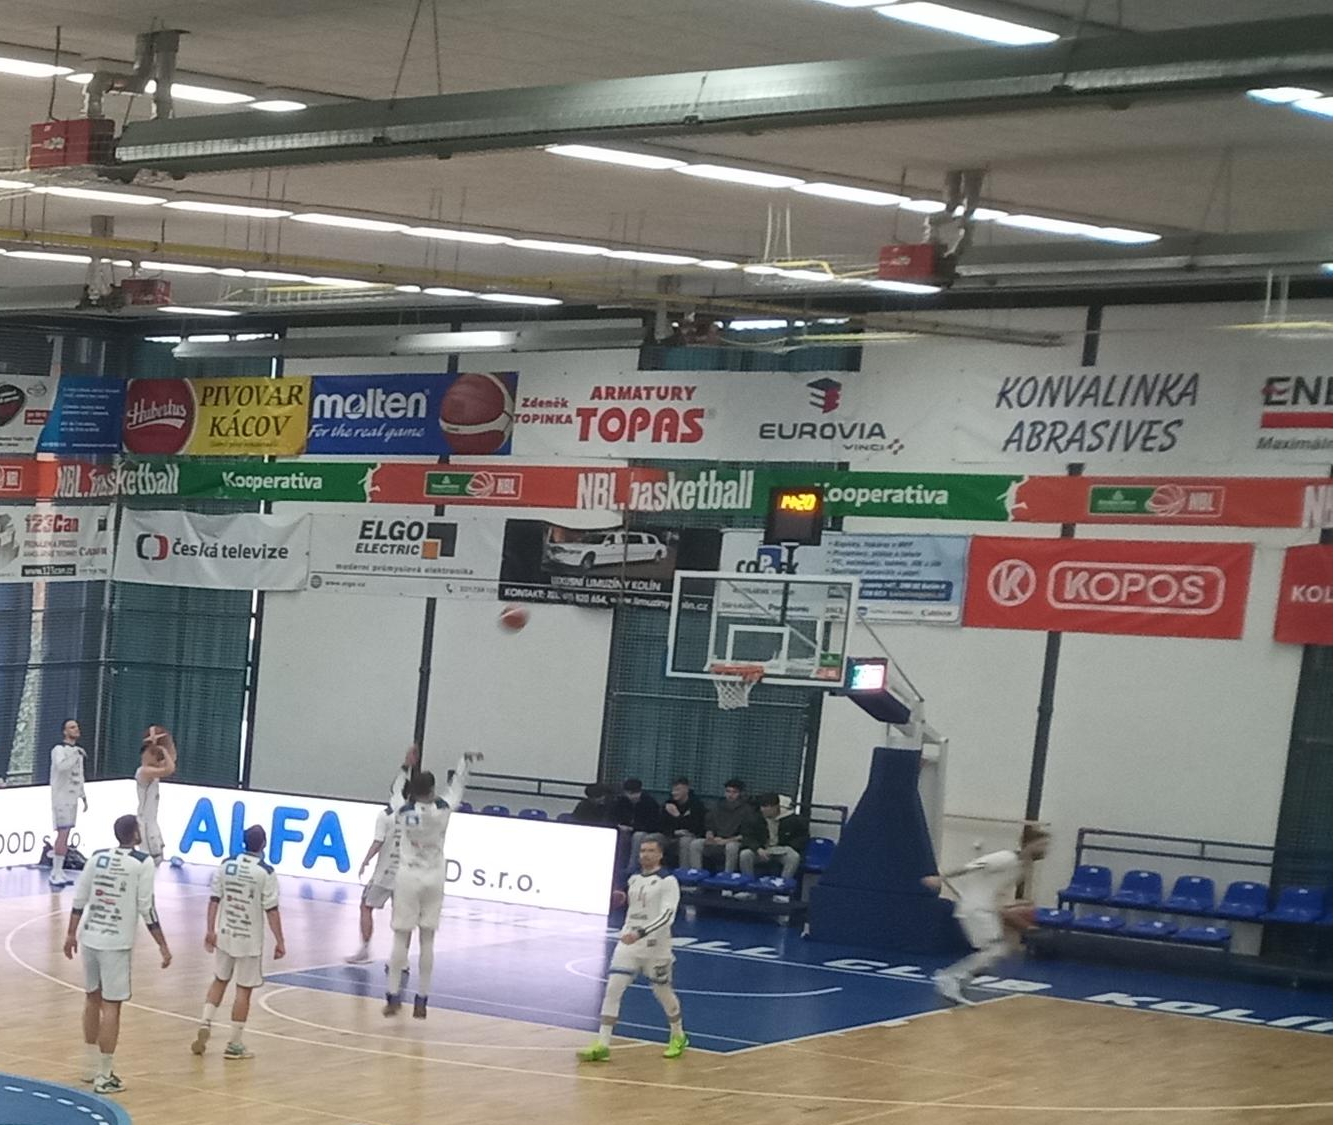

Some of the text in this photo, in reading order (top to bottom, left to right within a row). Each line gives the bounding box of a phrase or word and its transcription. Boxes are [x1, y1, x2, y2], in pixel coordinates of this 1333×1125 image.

[199, 383, 304, 408] PIVOVAR
[589, 384, 697, 401] ARMATURY
[995, 372, 1200, 409] KONVALINKA
[311, 387, 427, 420] molten
[208, 410, 291, 438] KÁCOV
[514, 412, 573, 425] TOPINKA
[575, 407, 705, 444] TOPAS
[759, 420, 887, 441] EUROVIA
[308, 424, 426, 443] For the real game
[1002, 418, 1184, 453] ABRASIVES
[222, 470, 323, 493] Kooperativa
[358, 520, 424, 541] ELGO
[220, 542, 289, 560] televize
[355, 543, 420, 556] ELECTRIC
[1061, 570, 1206, 605] KOPOS
[179, 797, 351, 873] ALFA
